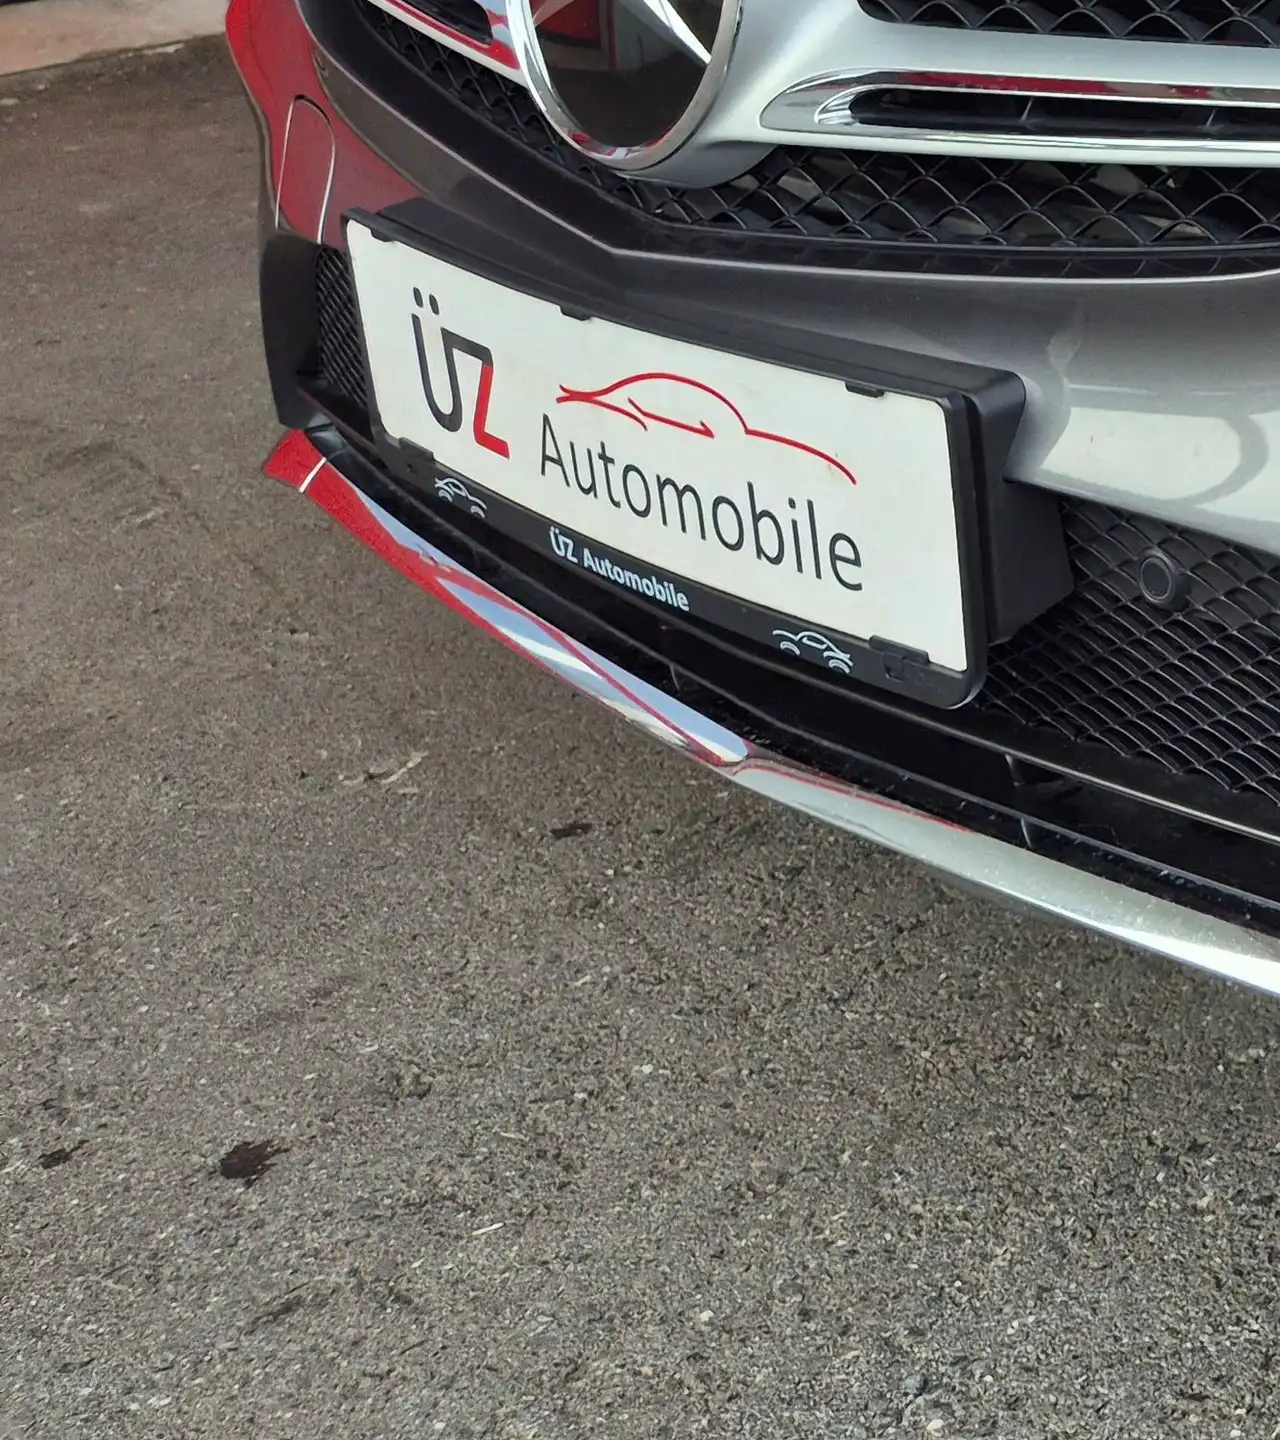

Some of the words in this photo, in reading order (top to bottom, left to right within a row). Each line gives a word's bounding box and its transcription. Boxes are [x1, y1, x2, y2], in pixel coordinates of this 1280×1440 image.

[411, 287, 510, 460] ÜZ
[540, 413, 863, 591] Automobile
[550, 525, 579, 564] ÜZ
[583, 547, 690, 612] Automobile
